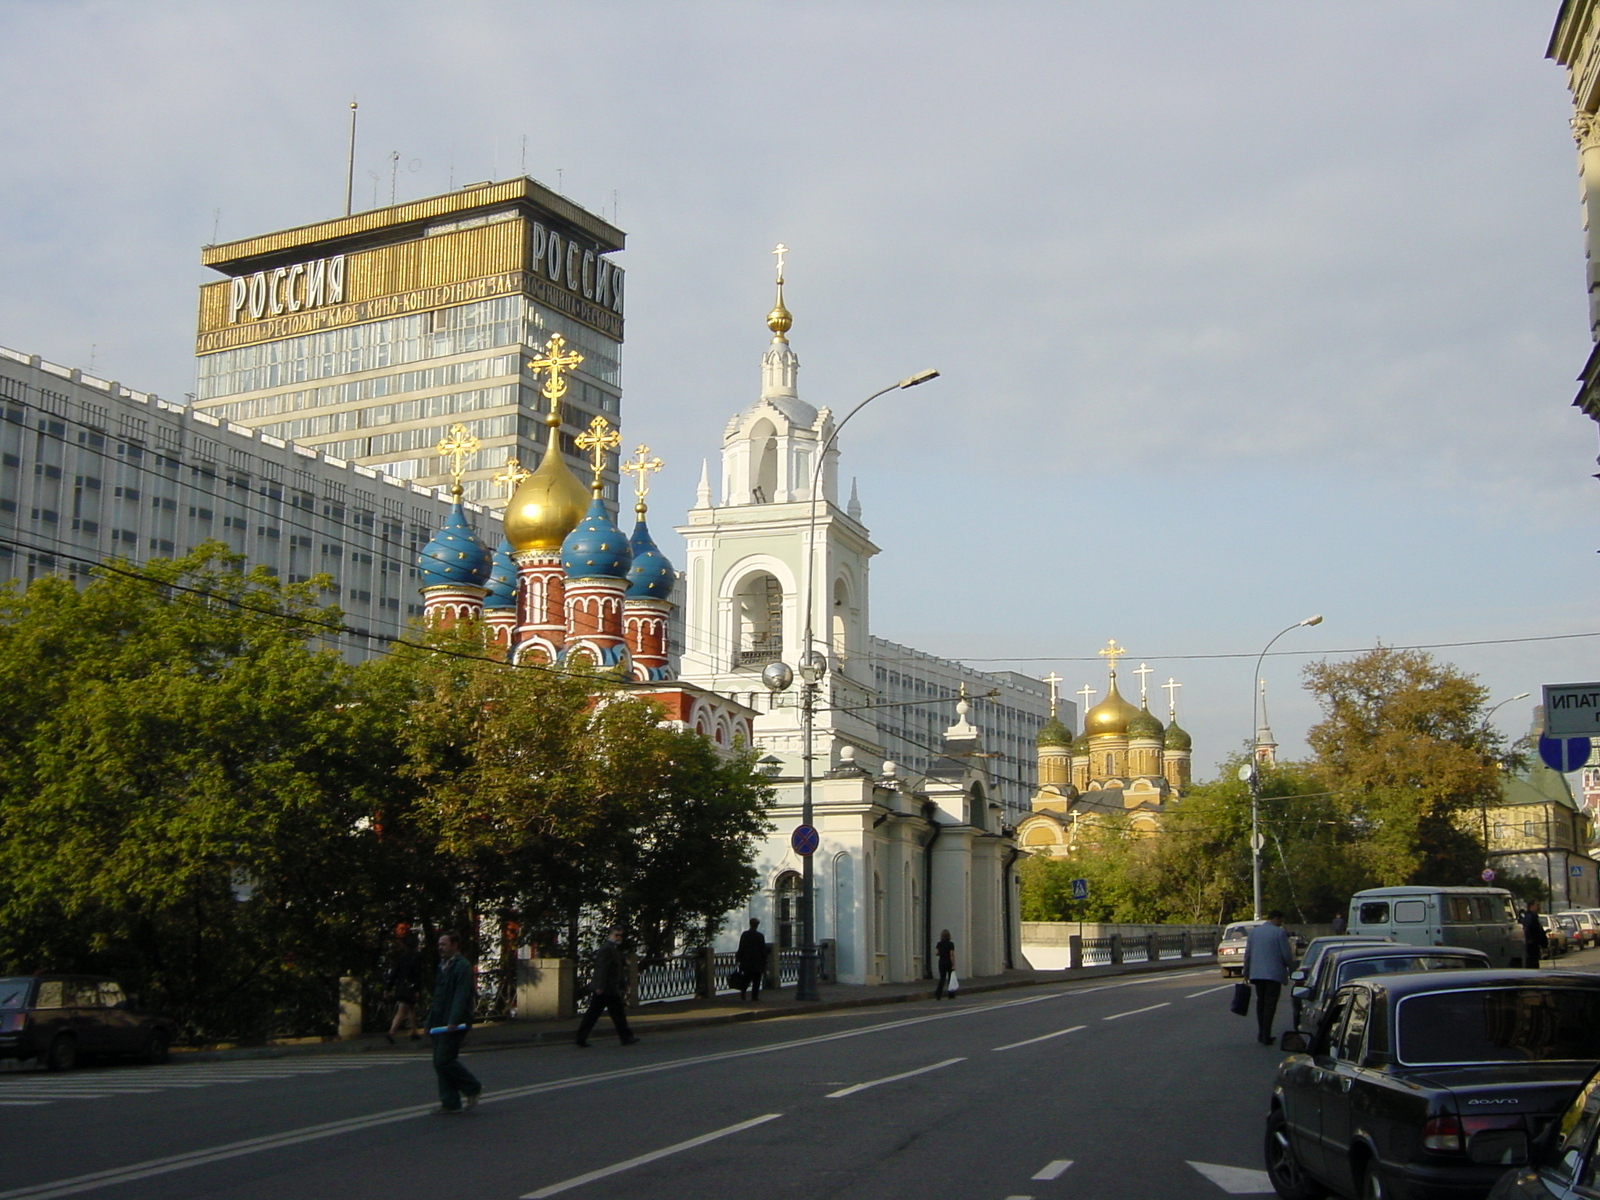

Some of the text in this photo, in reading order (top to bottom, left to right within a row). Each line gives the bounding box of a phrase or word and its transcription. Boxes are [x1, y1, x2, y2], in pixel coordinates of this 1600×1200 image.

[230, 254, 345, 323] РОССИЯ
[532, 221, 622, 314] РОССИЯ
[201, 329, 260, 351] ГОСТИНИЦА
[267, 314, 320, 336] РЕСТОРАН
[328, 304, 359, 327] КАФЕ
[490, 274, 511, 294] ЗАЛ
